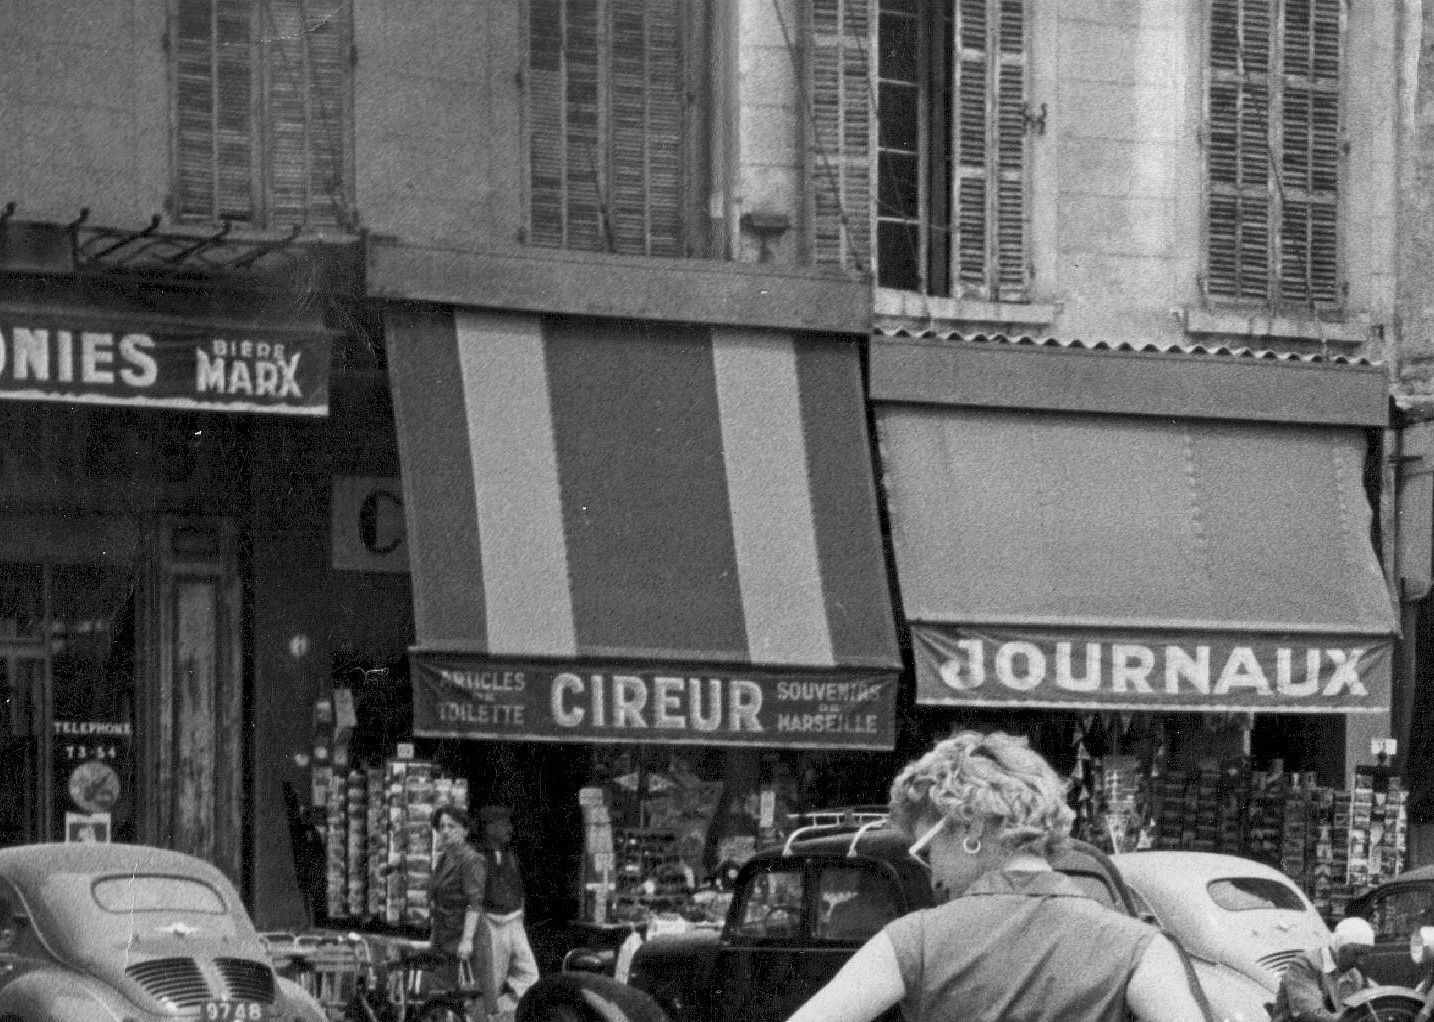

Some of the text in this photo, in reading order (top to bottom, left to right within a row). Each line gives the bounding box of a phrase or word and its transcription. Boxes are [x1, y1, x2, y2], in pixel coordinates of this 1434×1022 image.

[0, 326, 159, 388] NIES
[196, 348, 302, 396] MARX
[939, 639, 1370, 697] JOURNAUX
[439, 702, 525, 724] TOILETTE
[549, 671, 767, 734] CIREUR
[777, 714, 878, 735] MARSEILLE
